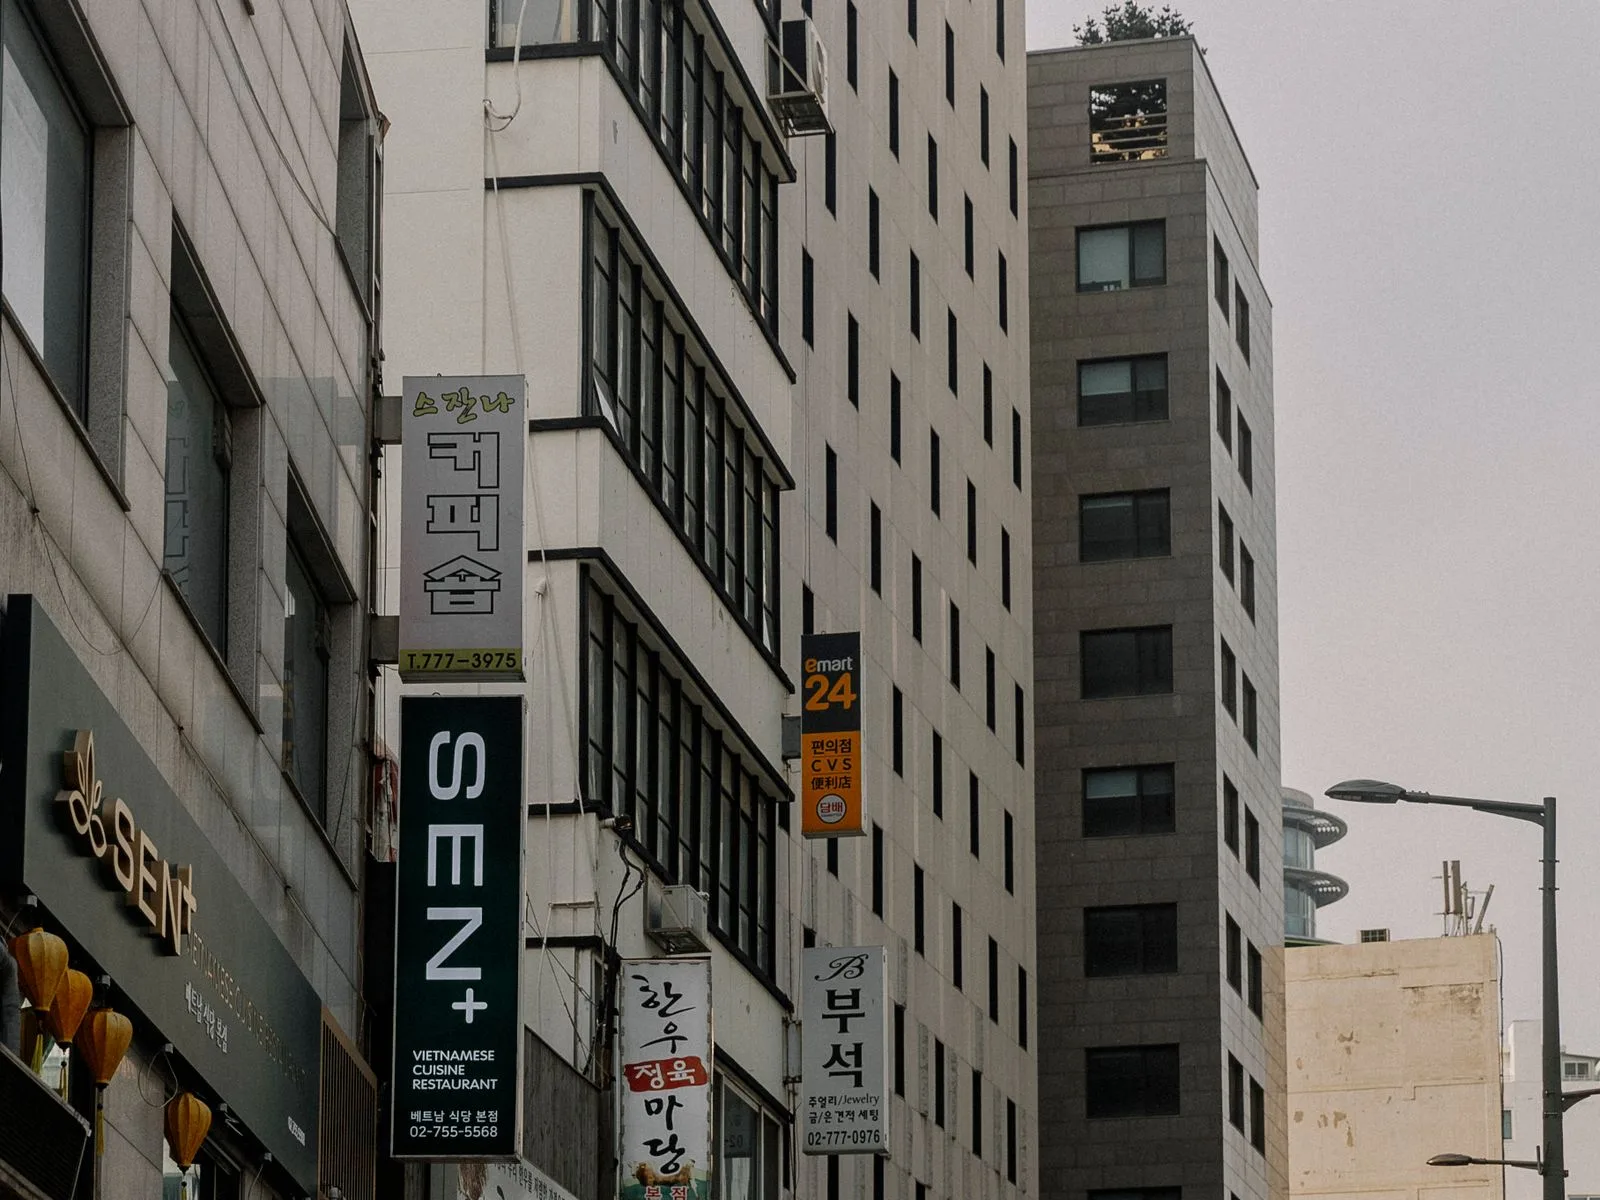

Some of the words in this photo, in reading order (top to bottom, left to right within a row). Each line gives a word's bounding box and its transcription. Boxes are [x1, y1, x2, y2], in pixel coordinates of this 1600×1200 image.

[422, 432, 502, 615] 커피숍
[407, 653, 517, 670] T.777-3975
[805, 656, 853, 673] emart
[805, 672, 857, 711] 24
[811, 738, 852, 755] 편의점
[811, 776, 852, 791] 便利店
[820, 801, 844, 814] 담배
[631, 974, 696, 1054] 한우
[822, 988, 866, 1088] 부석
[412, 1050, 496, 1061] VIETNAMESE
[412, 1064, 466, 1076] CUISINE
[633, 1059, 696, 1090] 정육
[412, 1078, 498, 1090] RESTAURANT
[410, 1110, 445, 1123] 베트남
[449, 1110, 472, 1123] 식당
[475, 1110, 499, 1123] 본점
[858, 1109, 879, 1122] 세팅
[409, 1125, 498, 1138] 02-755-5568
[642, 1095, 685, 1175] 마당
[807, 1129, 880, 1146] 02-777-0976
